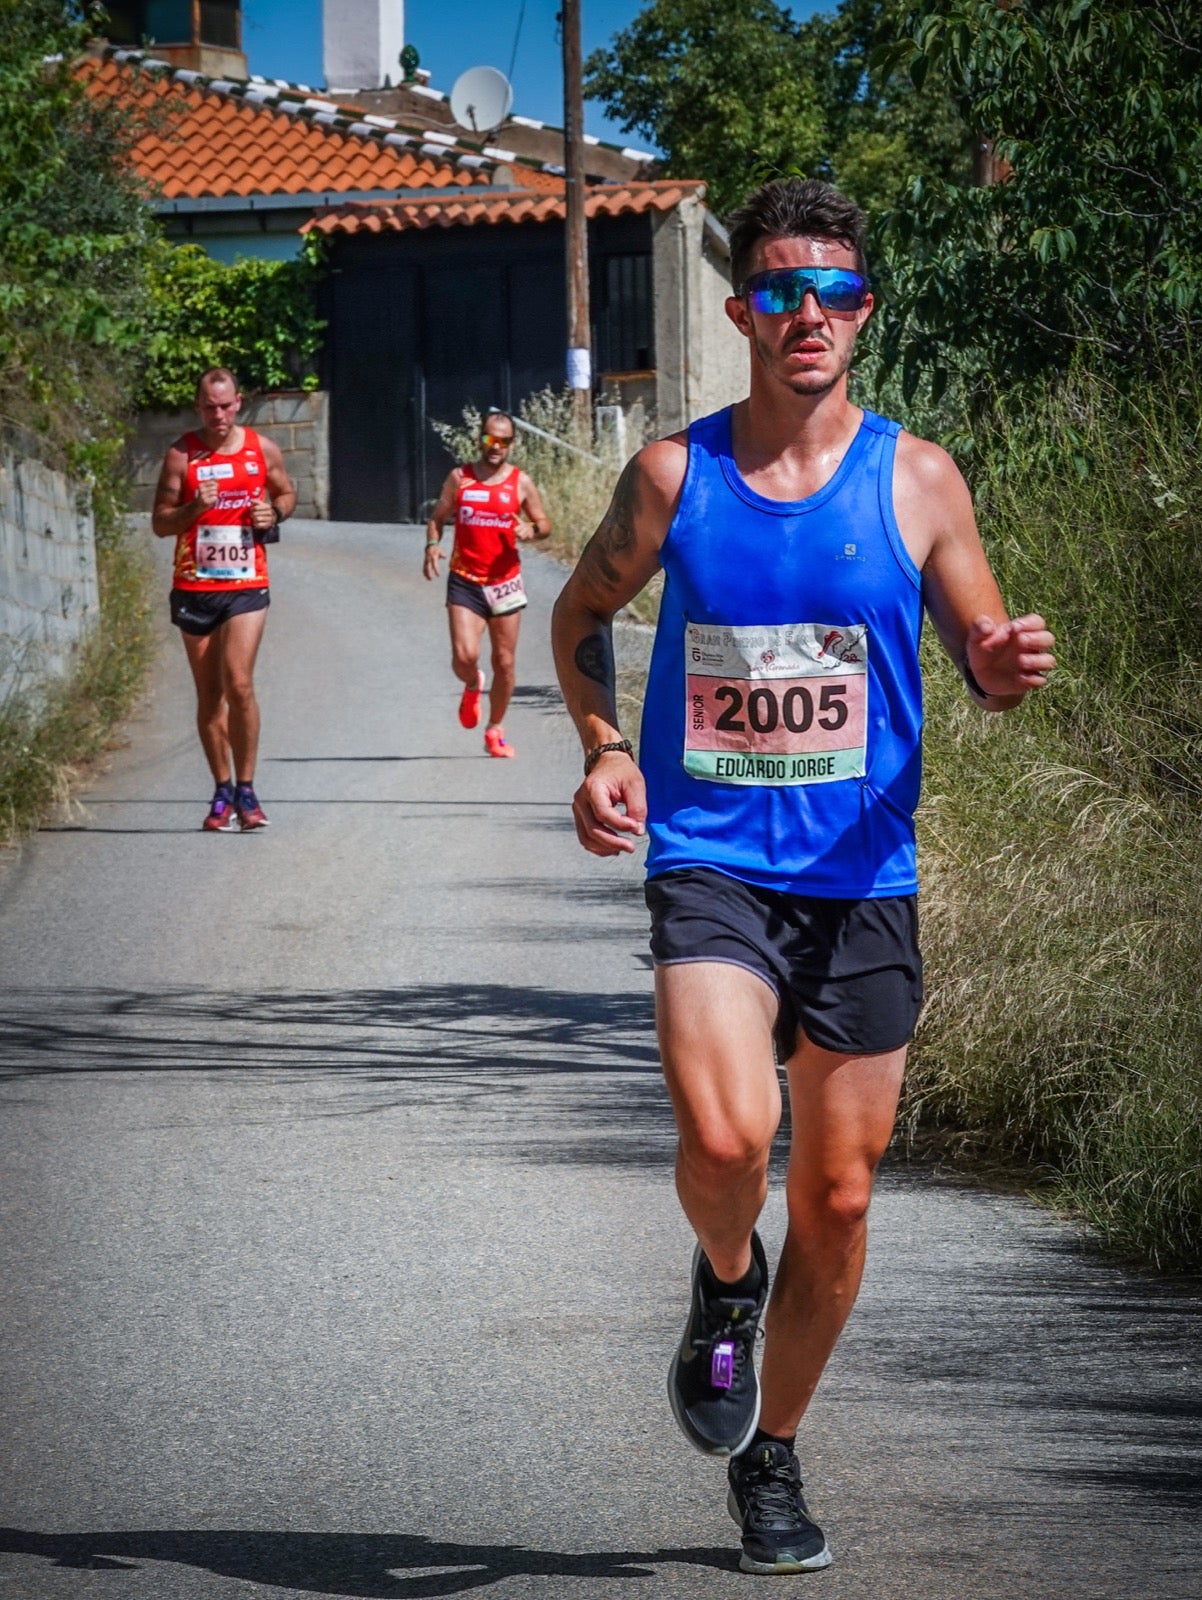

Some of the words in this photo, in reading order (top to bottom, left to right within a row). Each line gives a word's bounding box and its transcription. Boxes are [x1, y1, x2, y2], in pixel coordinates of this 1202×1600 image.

[206, 545, 249, 561] 2103
[693, 694, 704, 730] SENIOR
[714, 684, 849, 734] 2005
[715, 757, 786, 779] EDUARDO
[790, 757, 836, 778] JORGE
